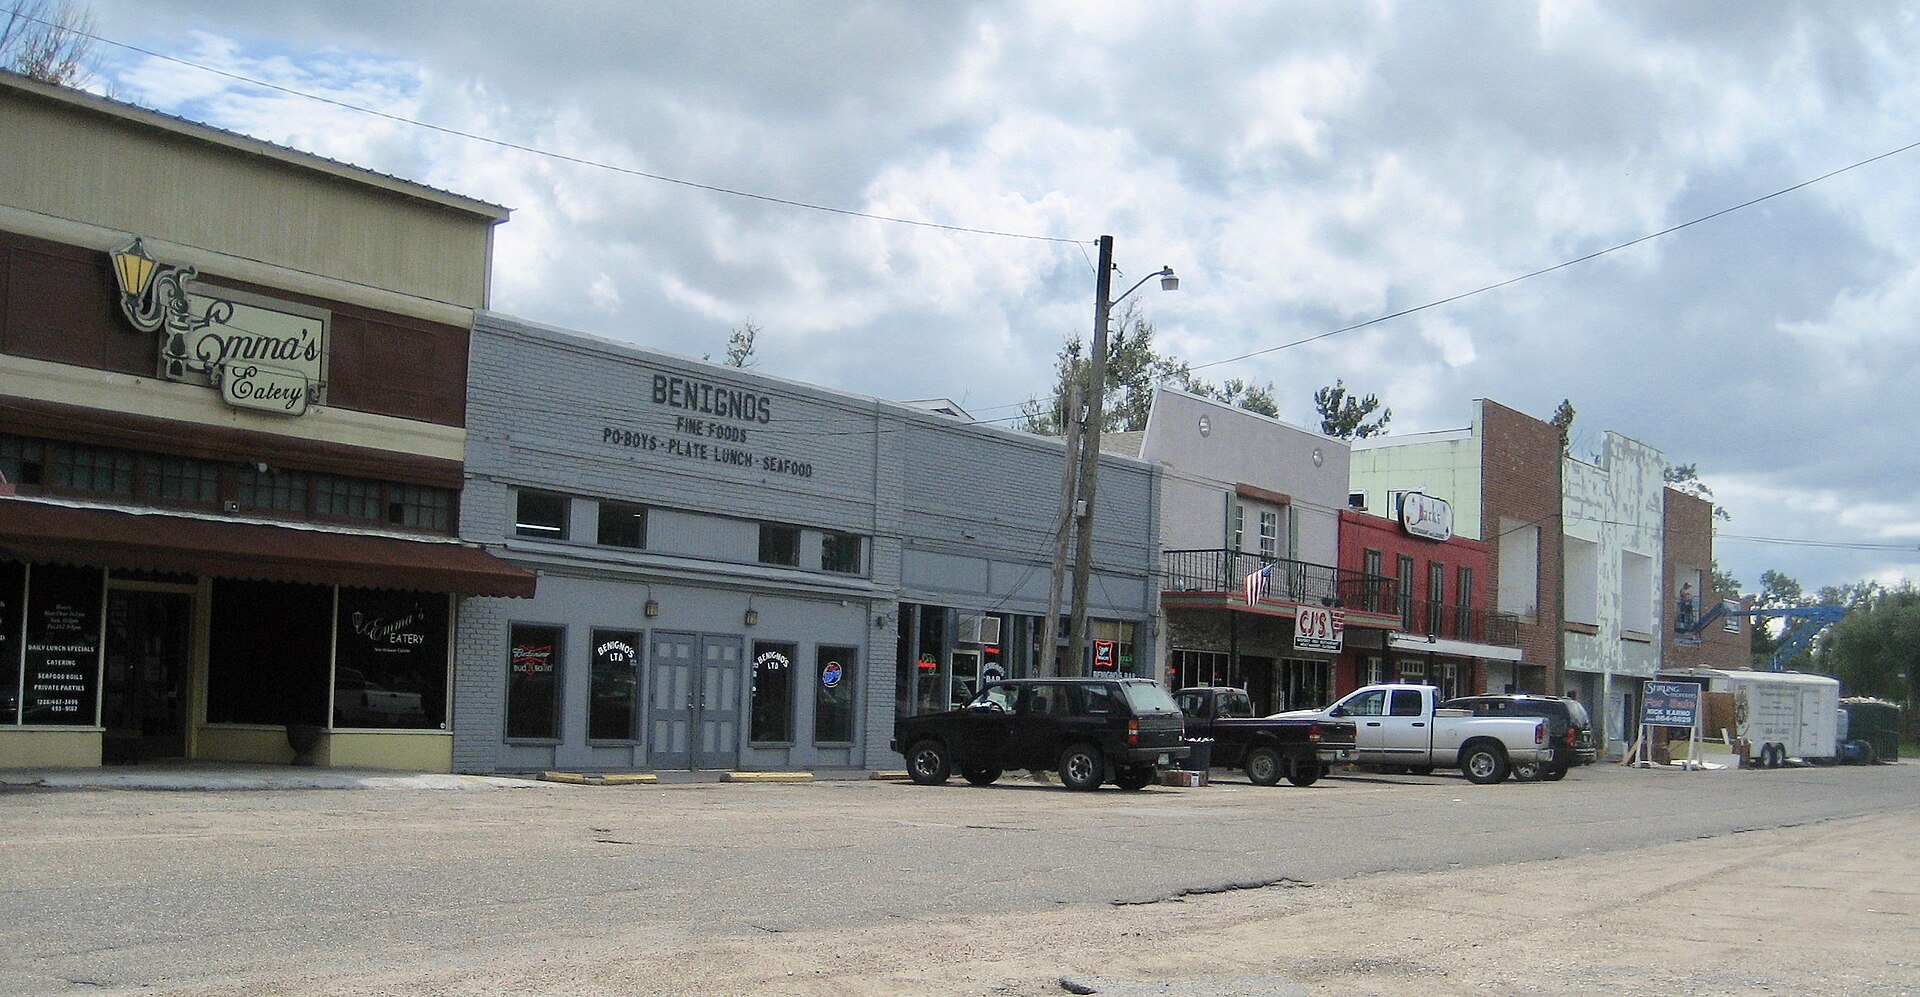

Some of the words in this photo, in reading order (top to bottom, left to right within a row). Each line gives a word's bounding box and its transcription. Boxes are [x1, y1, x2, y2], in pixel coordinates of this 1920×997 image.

[194, 300, 319, 366] Emma's
[231, 365, 302, 409] Eatery
[652, 374, 771, 424] BENIGNOS
[676, 416, 703, 436] FINE
[708, 423, 747, 443] FOODS
[603, 428, 657, 450] PO-BOYS
[669, 439, 707, 460] PLATE
[714, 446, 752, 467] LUNCH
[763, 457, 812, 478] SEAFOOD
[1300, 610, 1327, 638] CJ'S
[390, 632, 424, 644] EATERY
[597, 640, 635, 659] BENIGNO'S
[610, 653, 624, 662] LTD
[757, 651, 790, 668] BENIGNO'S
[767, 661, 779, 670] LTD
[986, 675, 1001, 683] BAR
